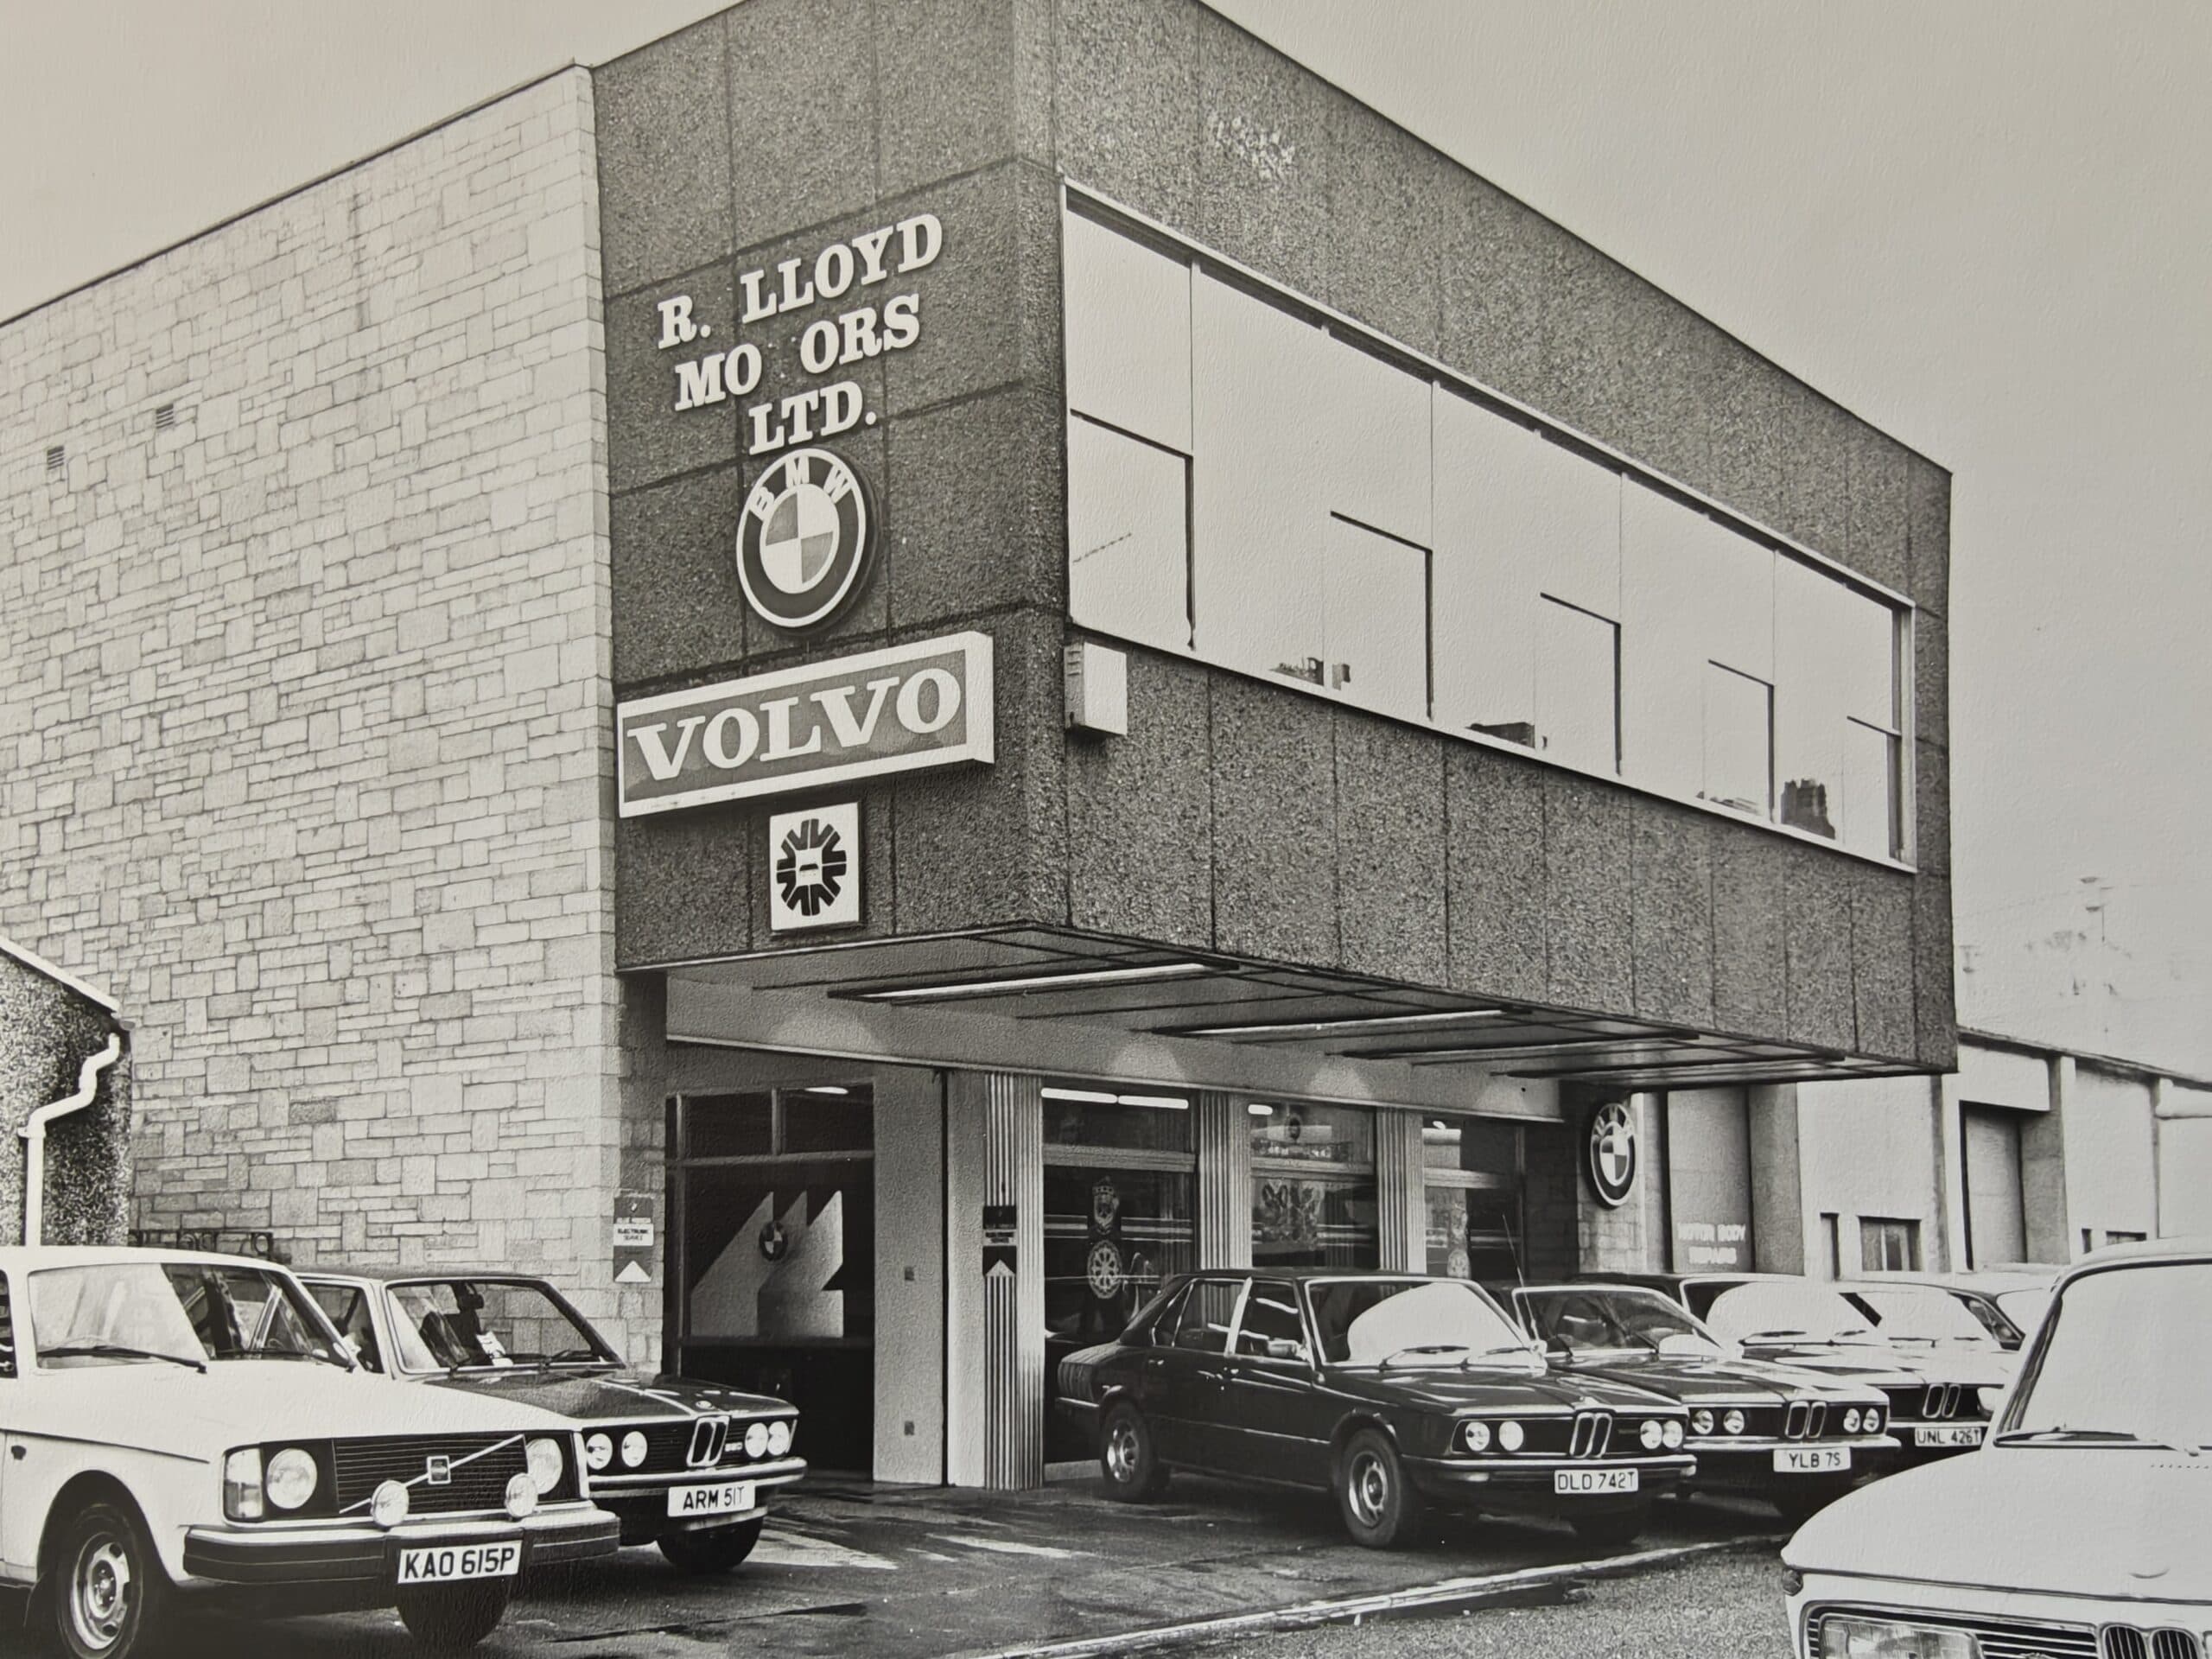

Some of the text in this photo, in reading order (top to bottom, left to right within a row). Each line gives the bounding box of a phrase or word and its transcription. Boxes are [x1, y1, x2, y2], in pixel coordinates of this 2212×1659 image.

[658, 213, 944, 350] R. LLOYD
[748, 380, 877, 455] LTD.
[748, 455, 853, 522] BMW
[626, 667, 962, 781] VOLVO
[1917, 1430, 1946, 1445] UNL
[1789, 1452, 1841, 1469] YLB 7S
[1598, 1471, 1635, 1490] 742T
[683, 1485, 745, 1511] ARM 51T
[404, 1547, 516, 1580] KAO 615P
